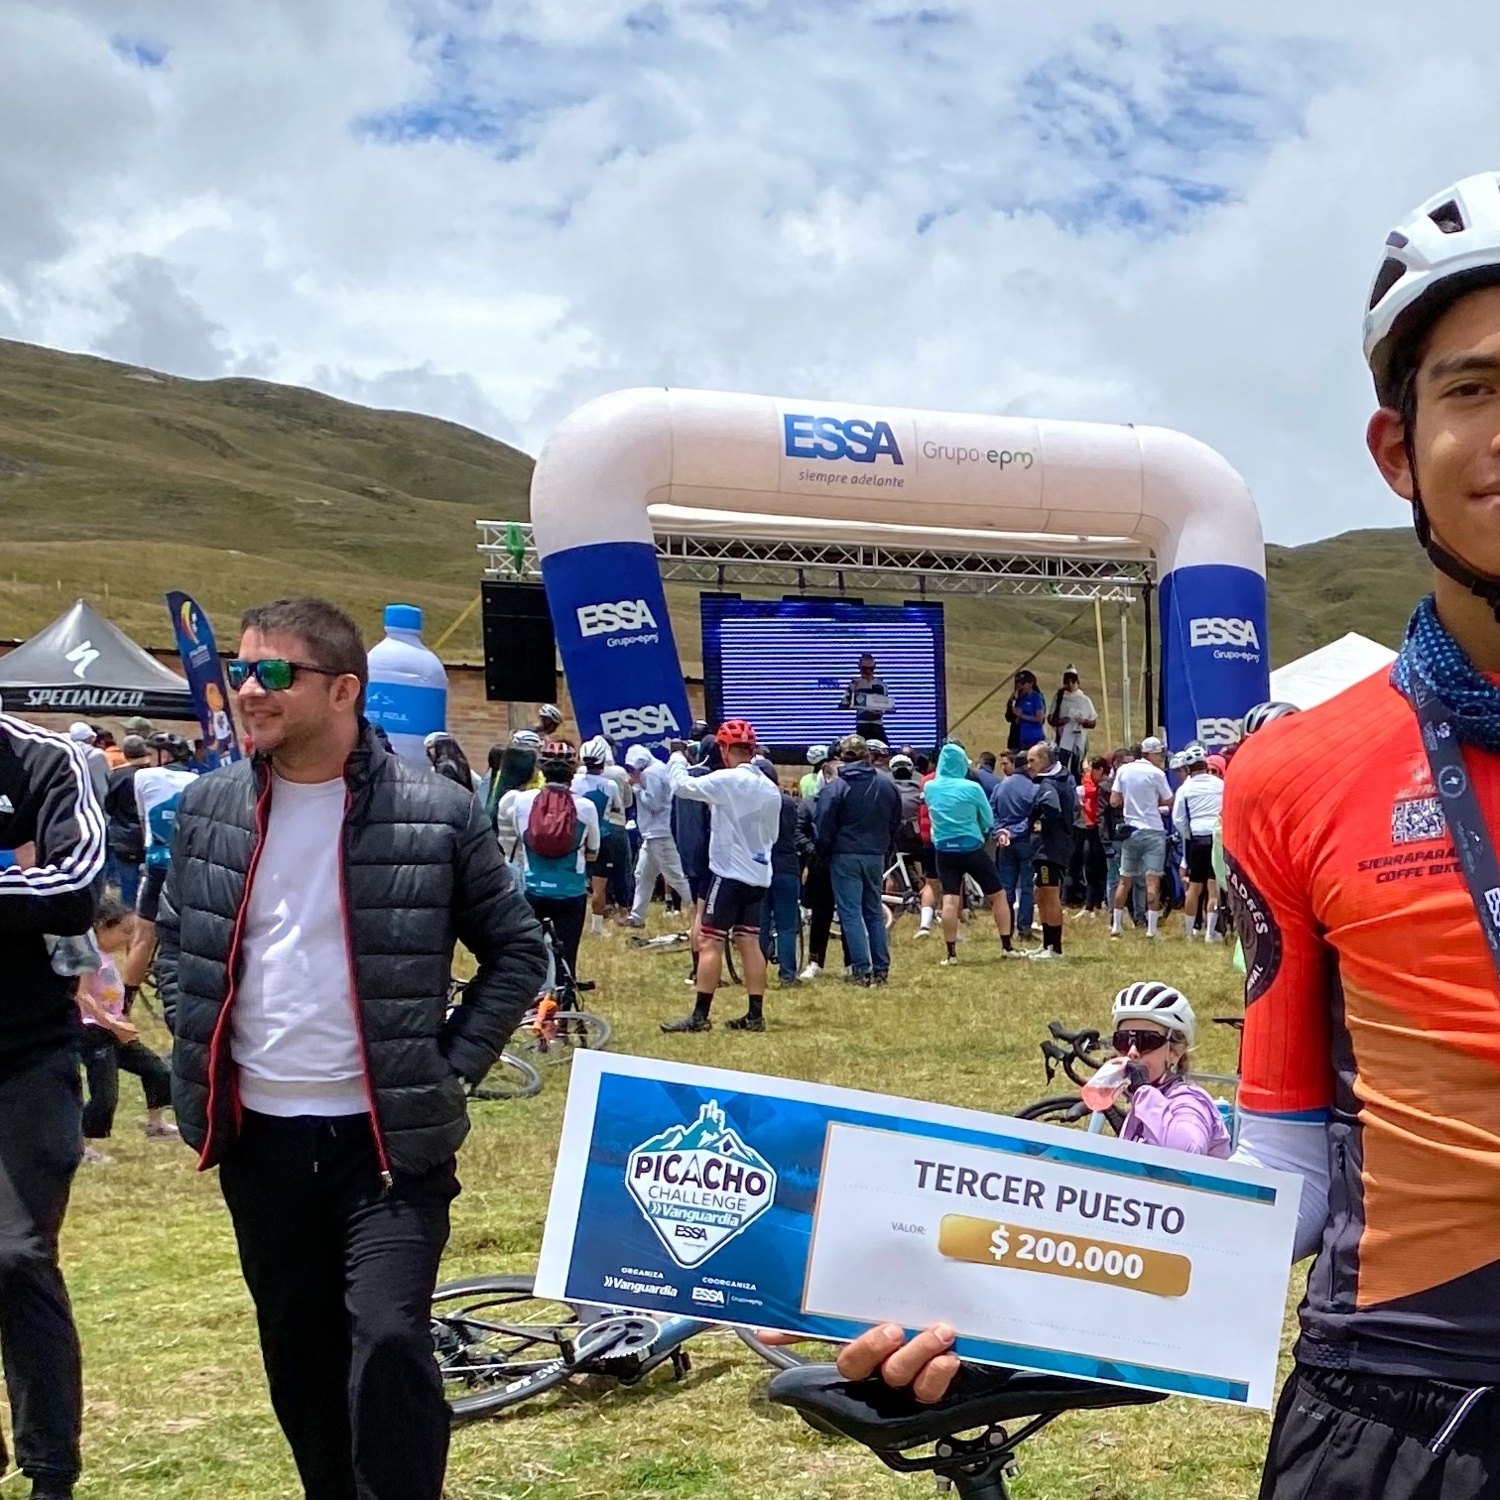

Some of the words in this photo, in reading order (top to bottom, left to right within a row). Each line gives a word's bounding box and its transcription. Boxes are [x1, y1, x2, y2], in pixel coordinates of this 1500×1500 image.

[784, 413, 904, 466] ESSA
[922, 440, 980, 466] Grupo
[986, 448, 1034, 471] epm
[799, 469, 848, 486] siempre
[850, 474, 904, 488] adelante
[576, 599, 658, 638] ESSA
[1189, 617, 1260, 650] ESSA
[24, 688, 145, 707] SPECIALIZED
[600, 703, 681, 741] ESSA
[1196, 717, 1245, 746] ESS
[634, 1153, 767, 1197] PICACHO
[648, 1184, 747, 1213] CHALLENGE
[914, 1159, 1046, 1209] TERCER
[1055, 1184, 1185, 1235] PUESTO
[660, 1203, 740, 1228] Vanguardia
[674, 1224, 708, 1242] ESSA
[1015, 1232, 1144, 1280] 200.000
[612, 1276, 679, 1298] Vanguardia
[620, 1266, 665, 1280] ORGANIZA
[702, 1276, 757, 1291] COORGANIZA
[691, 1286, 725, 1304] ESSA
